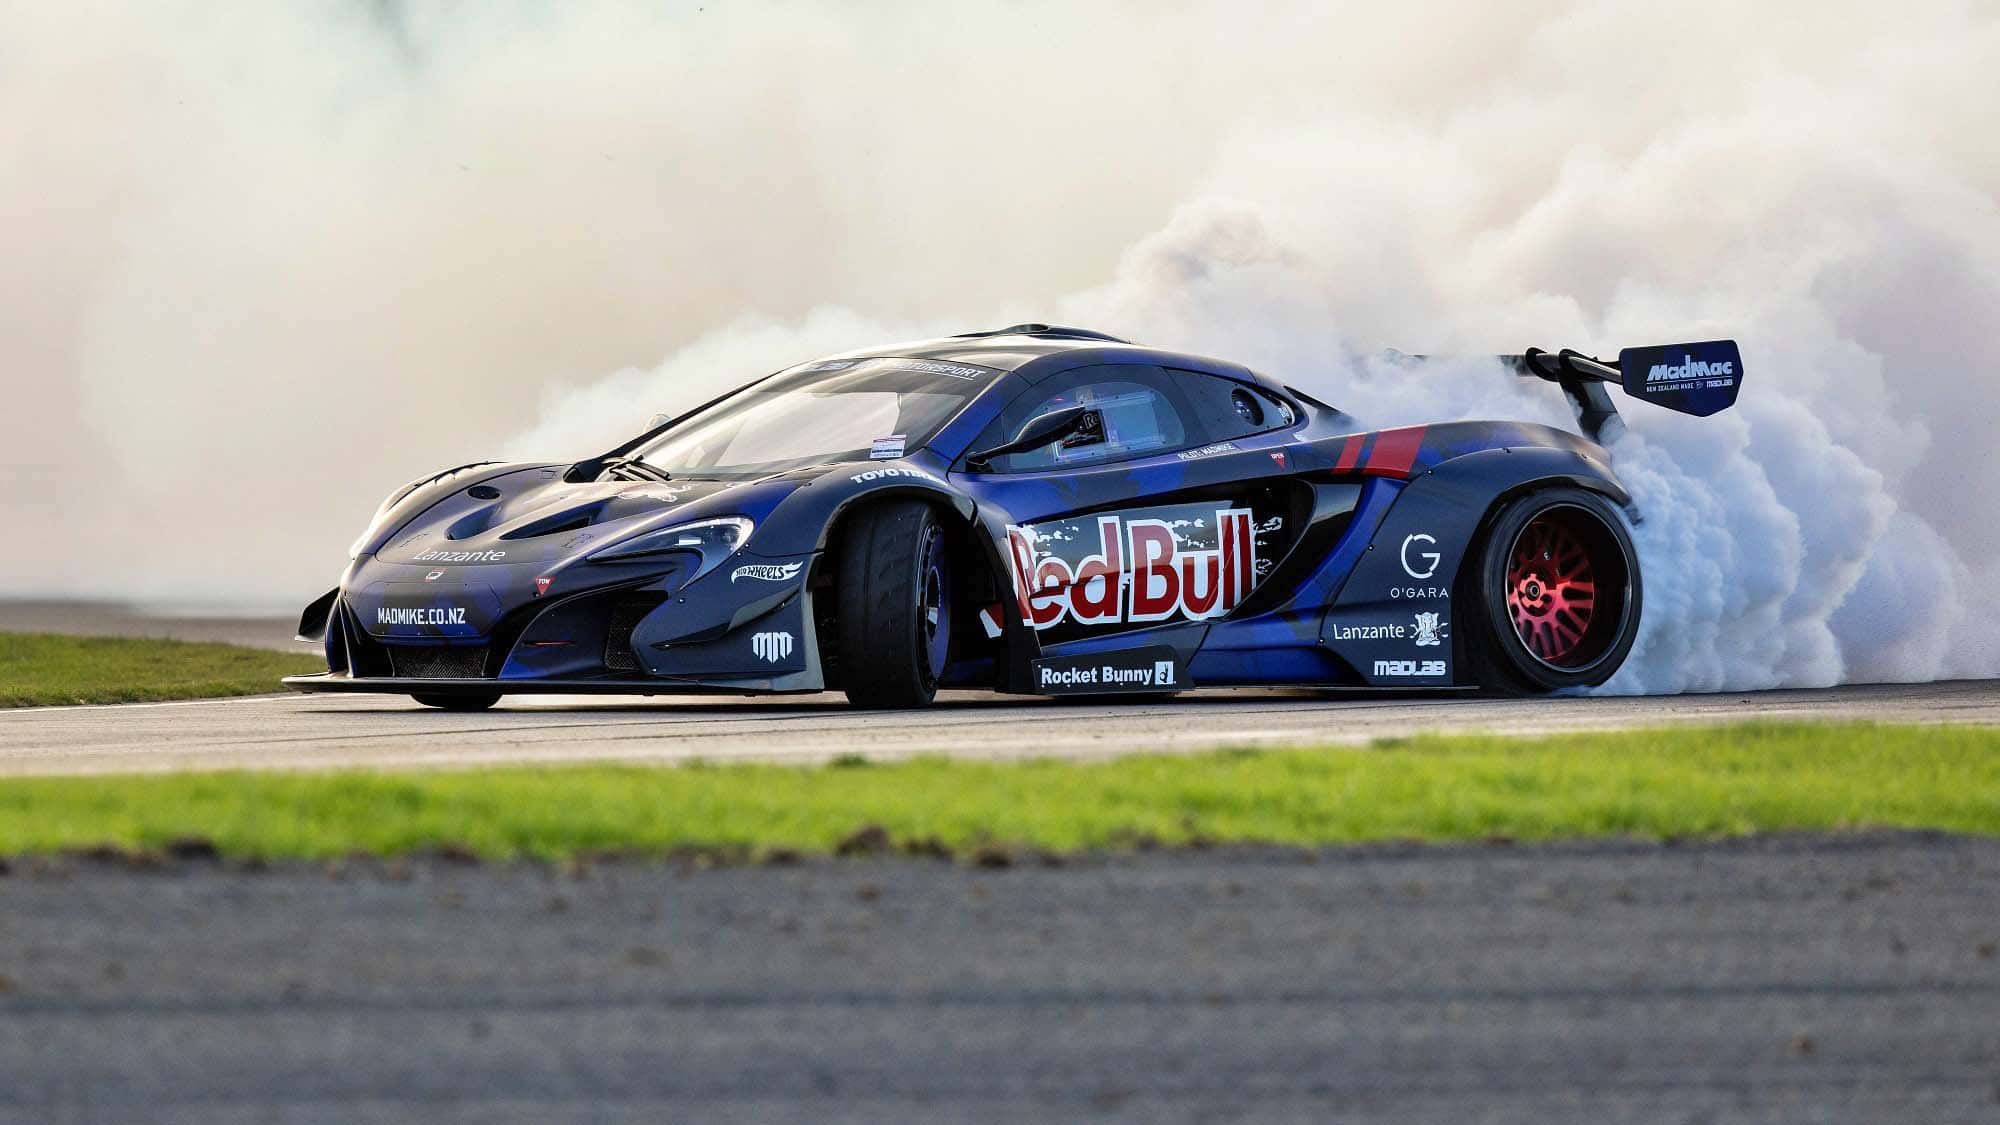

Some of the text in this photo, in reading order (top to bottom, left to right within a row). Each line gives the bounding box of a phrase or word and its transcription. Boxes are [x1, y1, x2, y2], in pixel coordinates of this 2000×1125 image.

[1647, 354, 1732, 381] MadMac
[850, 468, 899, 484] TOYO
[413, 547, 506, 561] Lanzante
[1005, 507, 1256, 630] Red Bull
[1390, 587, 1449, 598] O'GARA
[377, 607, 466, 625] MADMIKE.CO.NZ
[1333, 623, 1405, 640] Lanzante
[1041, 666, 1152, 686] Rocket Bunny
